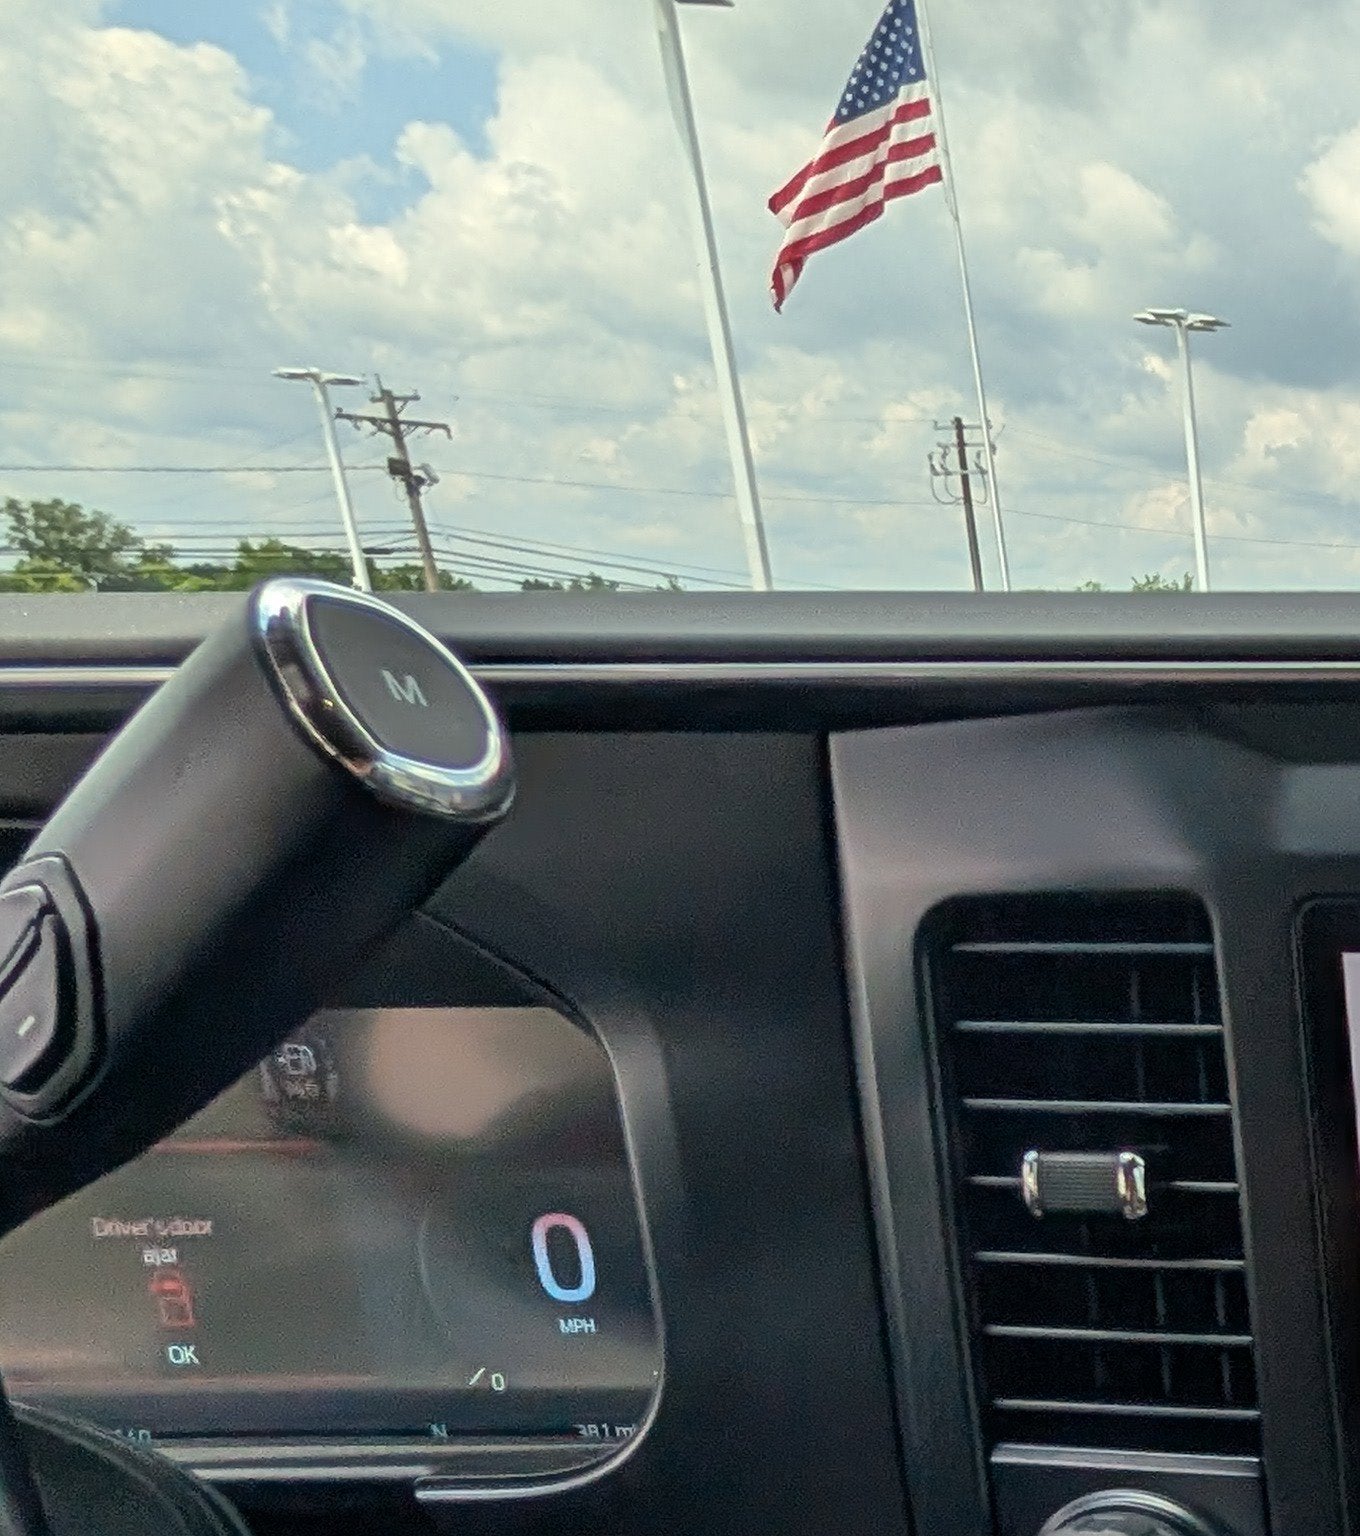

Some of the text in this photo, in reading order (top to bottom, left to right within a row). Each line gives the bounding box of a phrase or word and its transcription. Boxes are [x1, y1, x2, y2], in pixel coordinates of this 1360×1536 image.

[380, 668, 428, 707] M
[531, 1212, 597, 1304] 0
[558, 1317, 596, 1335] MPH
[167, 1344, 200, 1366] OK
